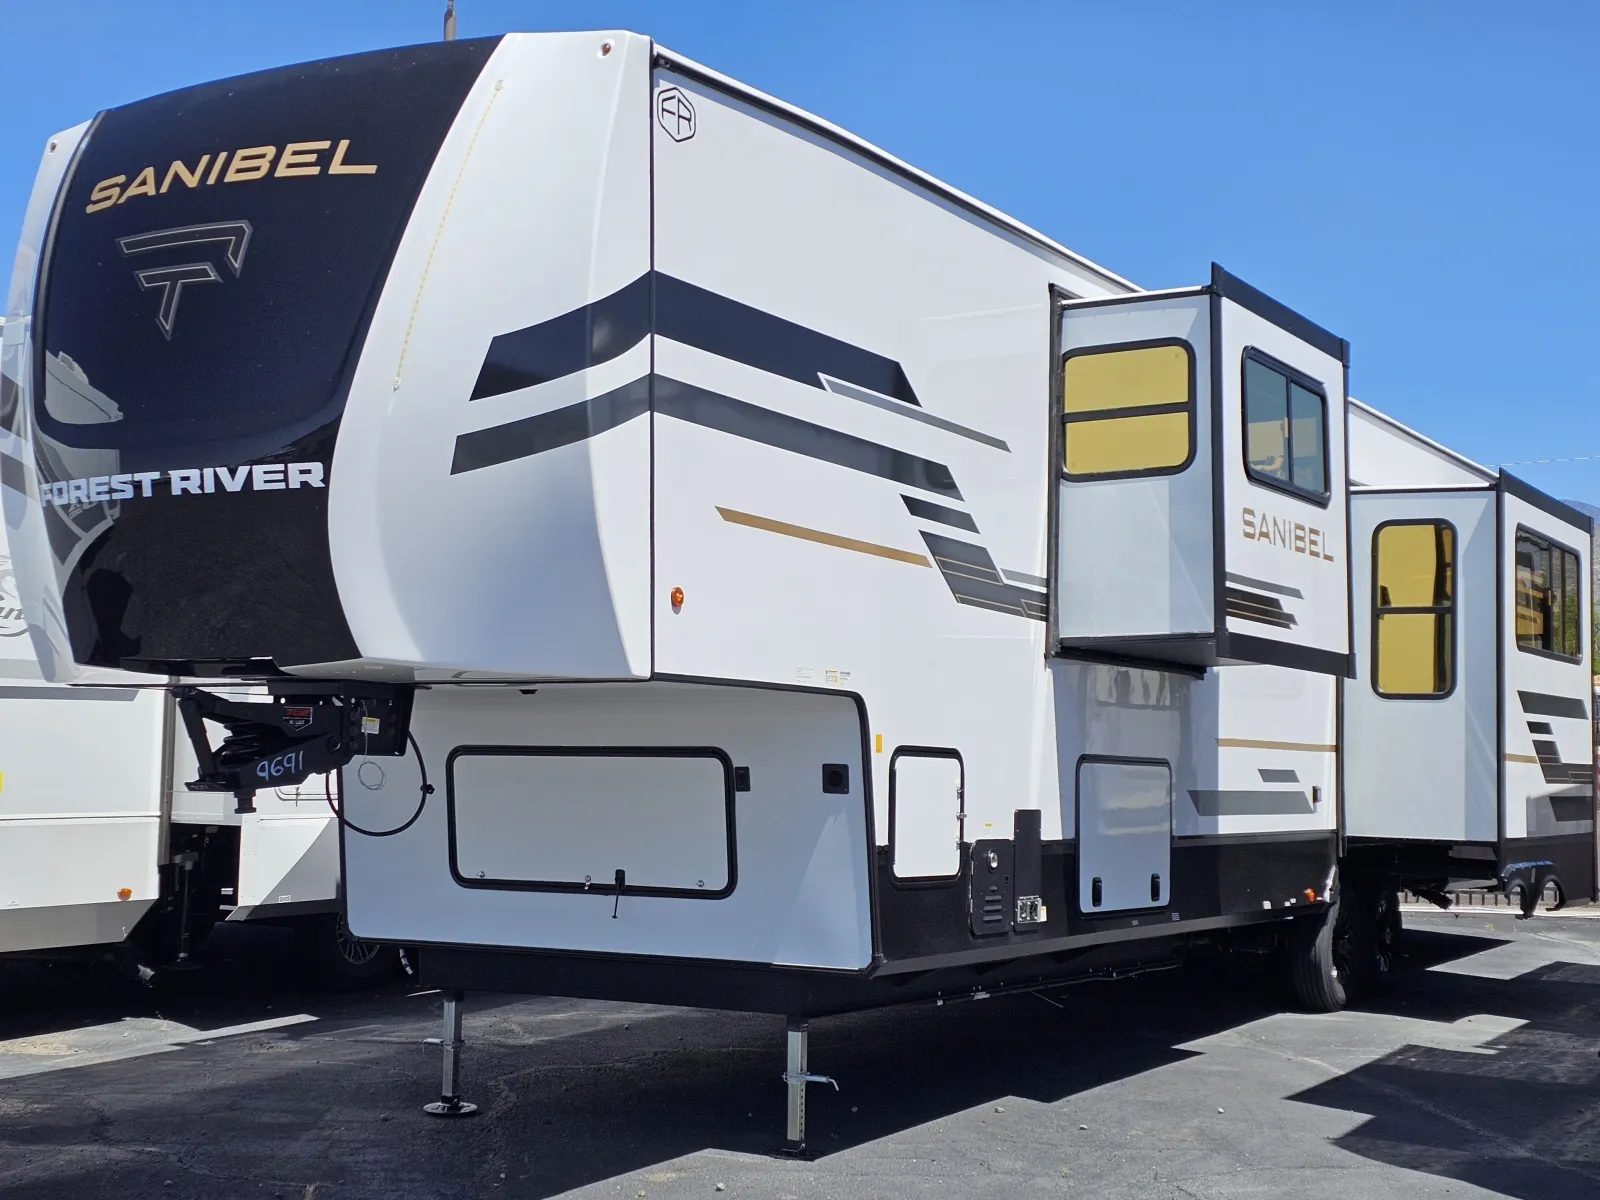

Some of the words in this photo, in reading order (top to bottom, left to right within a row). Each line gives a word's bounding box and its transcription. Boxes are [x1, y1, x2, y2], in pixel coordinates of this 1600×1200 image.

[662, 95, 692, 135] FR
[86, 139, 378, 213] SANIBEL
[39, 471, 161, 507] FOREST
[167, 461, 326, 496] RIVER
[1242, 506, 1334, 562] SANIBEL
[256, 750, 304, 781] 9691
